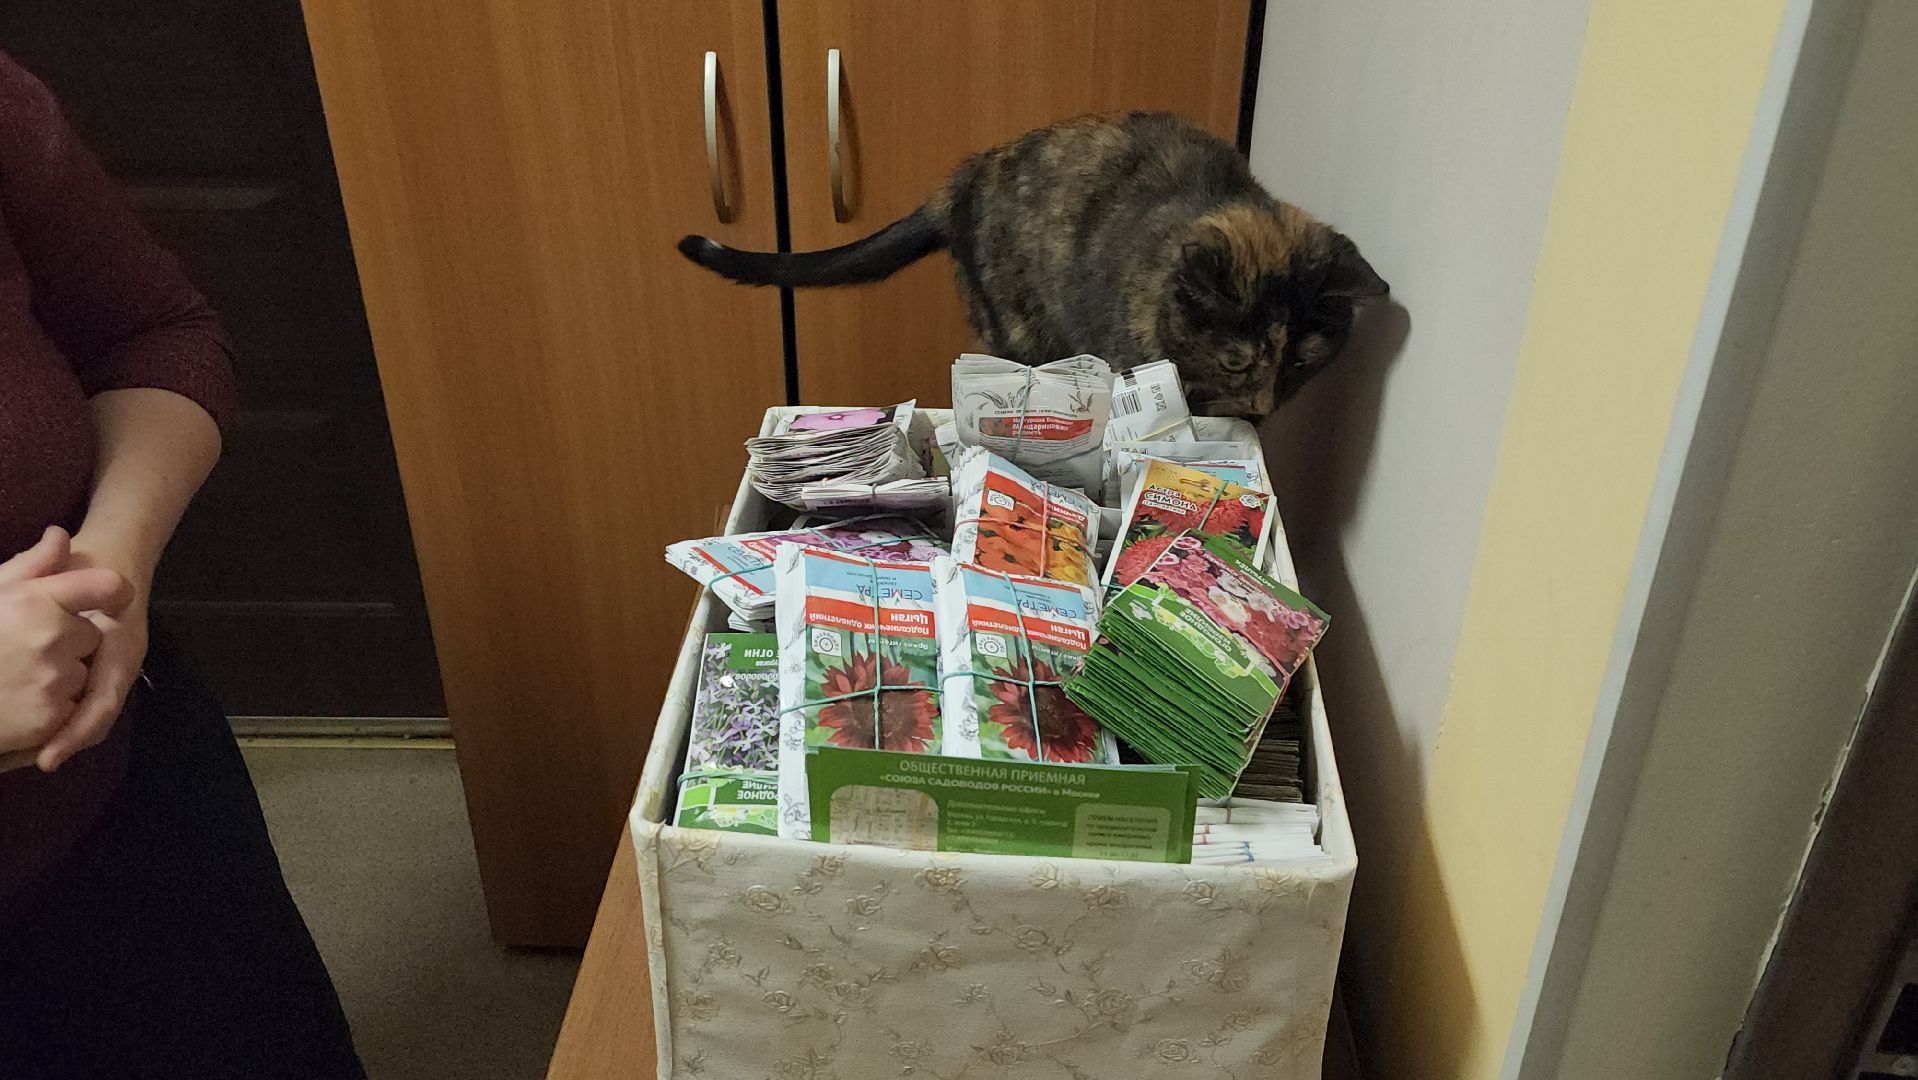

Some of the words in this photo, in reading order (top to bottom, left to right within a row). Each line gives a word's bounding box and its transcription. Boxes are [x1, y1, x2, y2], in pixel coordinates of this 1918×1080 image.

[1146, 484, 1181, 498] Астра
[1144, 491, 1198, 511] СИМОНА
[890, 612, 929, 626] Цыган
[863, 622, 930, 635] Подсолнечик
[1051, 624, 1086, 641] Цыган
[744, 648, 773, 659] ОГНИ
[899, 760, 1007, 780] ОБЩЕСТВЕННАЯ
[1011, 769, 1086, 786] ПРИЕМНАЯ
[924, 776, 999, 790] САДОВОДОВ
